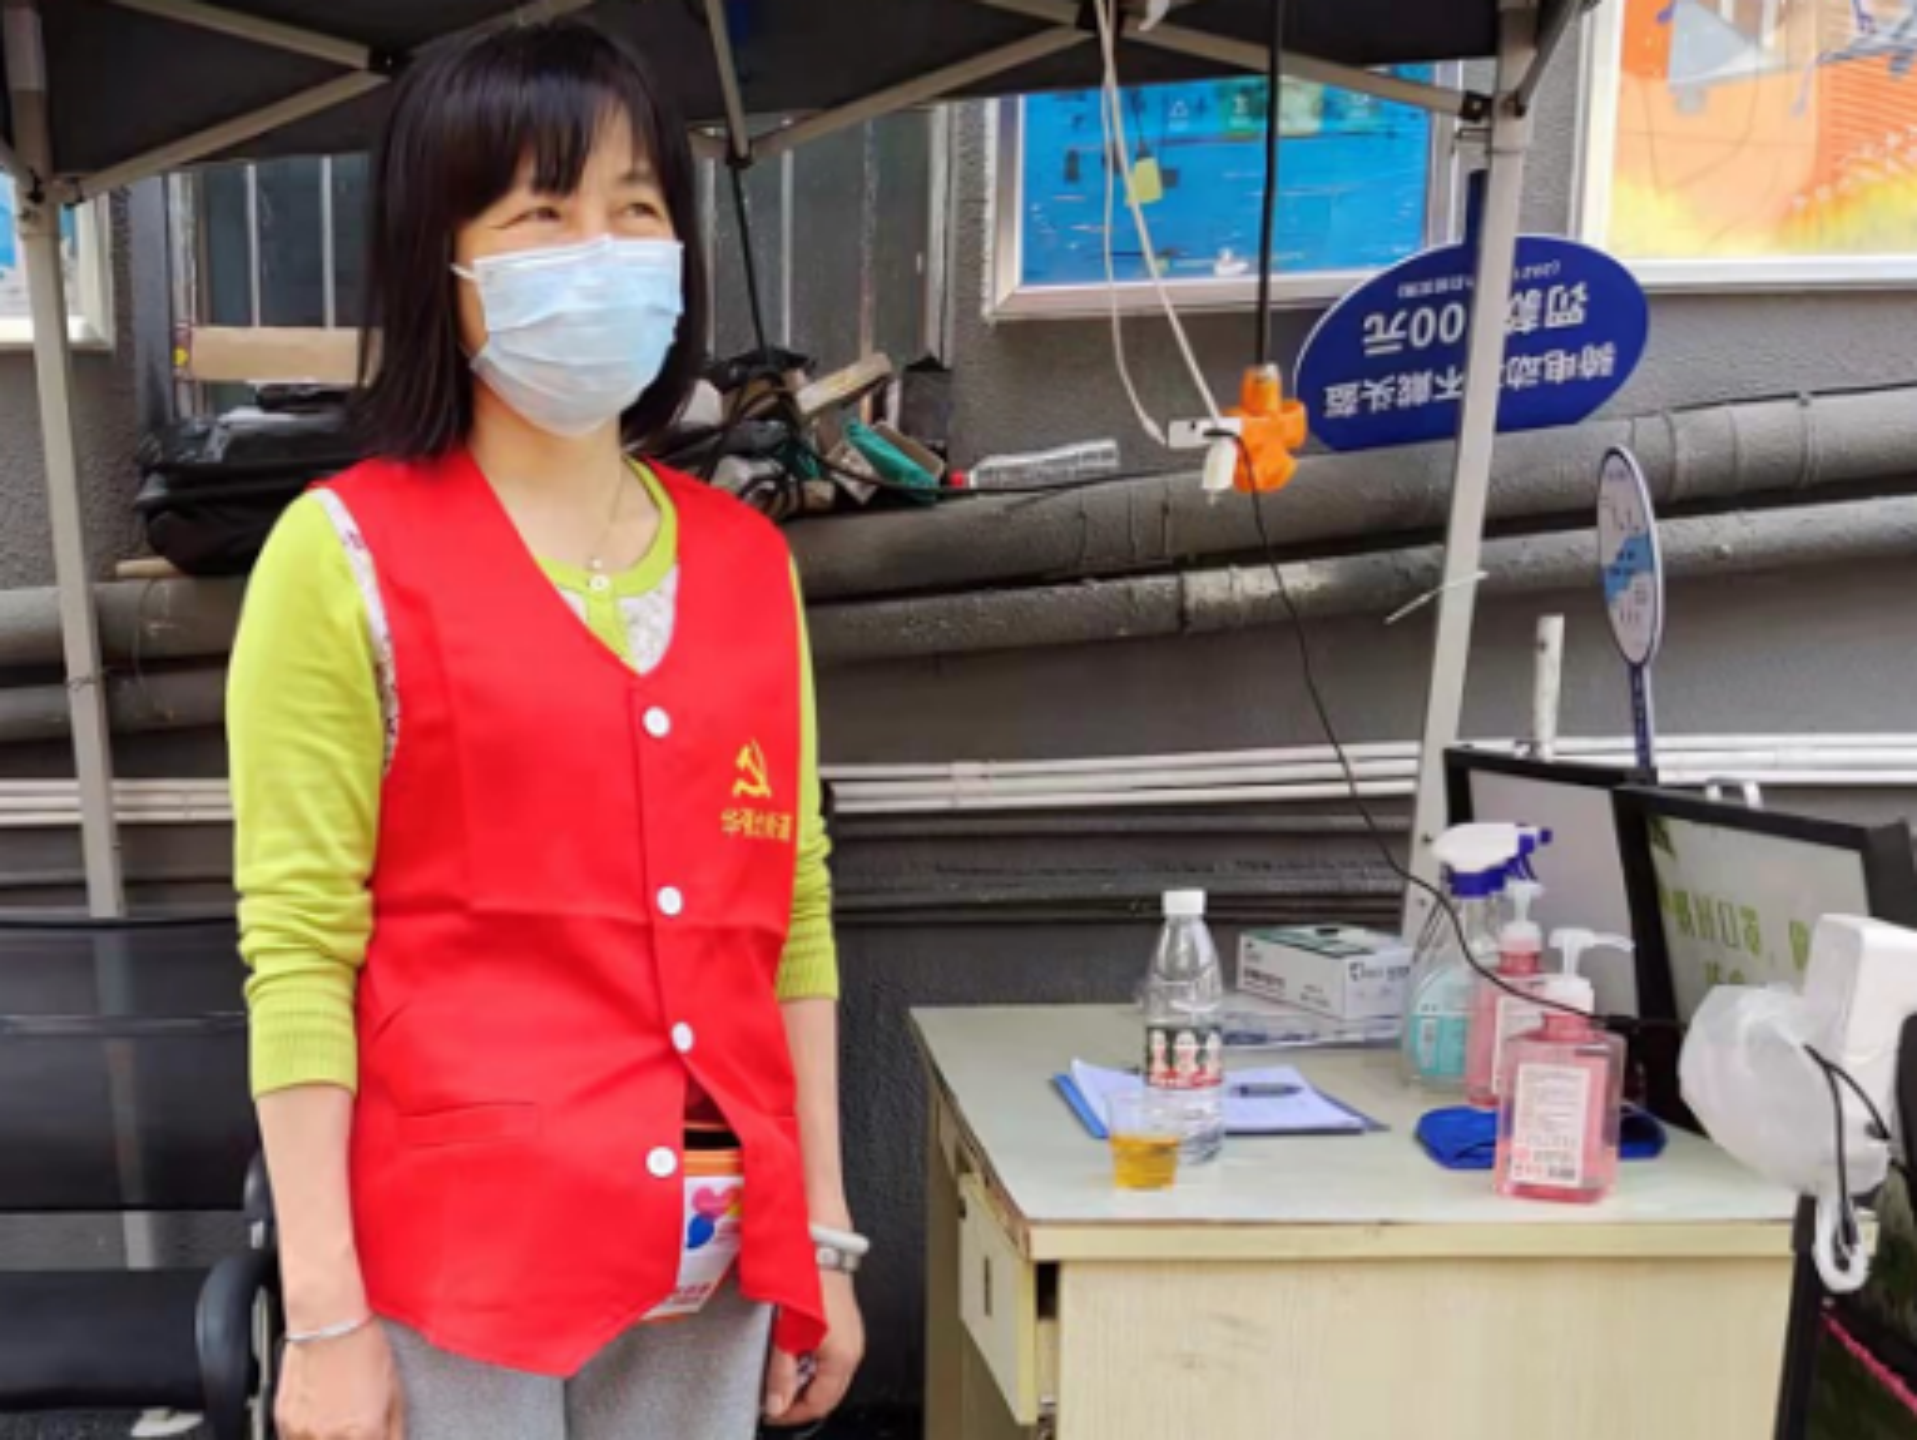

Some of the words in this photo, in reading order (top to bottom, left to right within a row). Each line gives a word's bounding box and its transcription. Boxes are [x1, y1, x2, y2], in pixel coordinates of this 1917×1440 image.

[1362, 282, 1588, 357] 罚款00元
[1323, 342, 1617, 419] 骑电动不戴头盔
